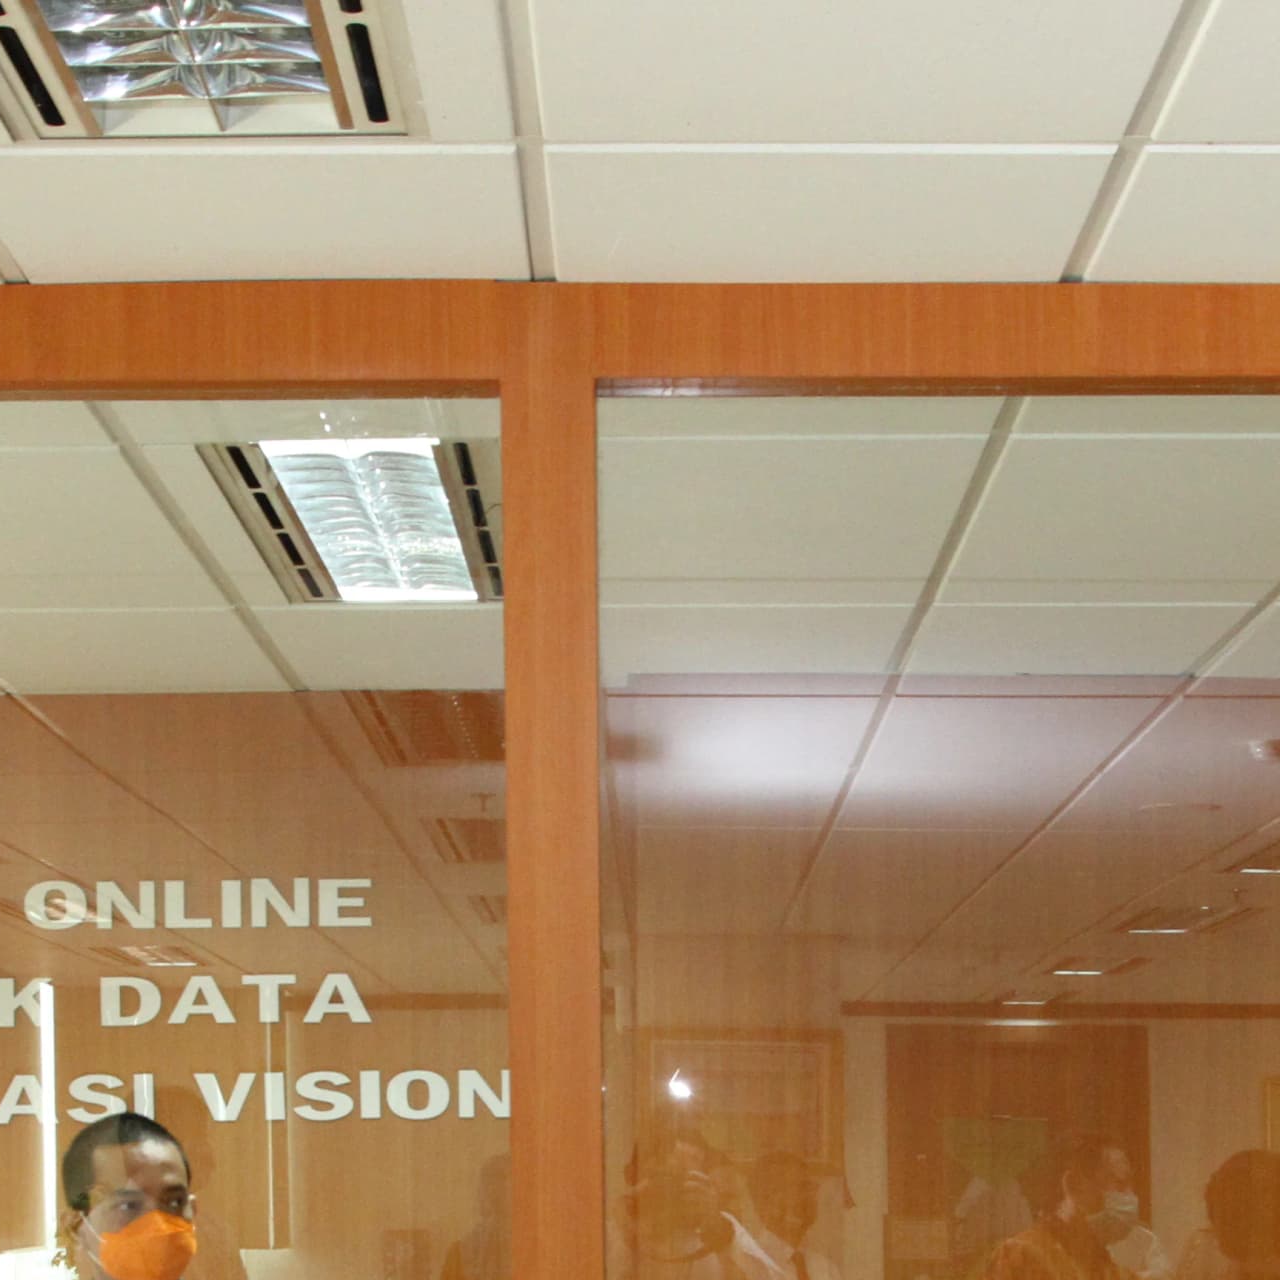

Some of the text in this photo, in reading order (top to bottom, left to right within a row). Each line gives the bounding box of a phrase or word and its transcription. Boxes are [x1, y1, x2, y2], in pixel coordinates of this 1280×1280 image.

[23, 878, 373, 929] ONLINE
[100, 973, 373, 1026] DATA
[193, 1069, 512, 1121] VISION
